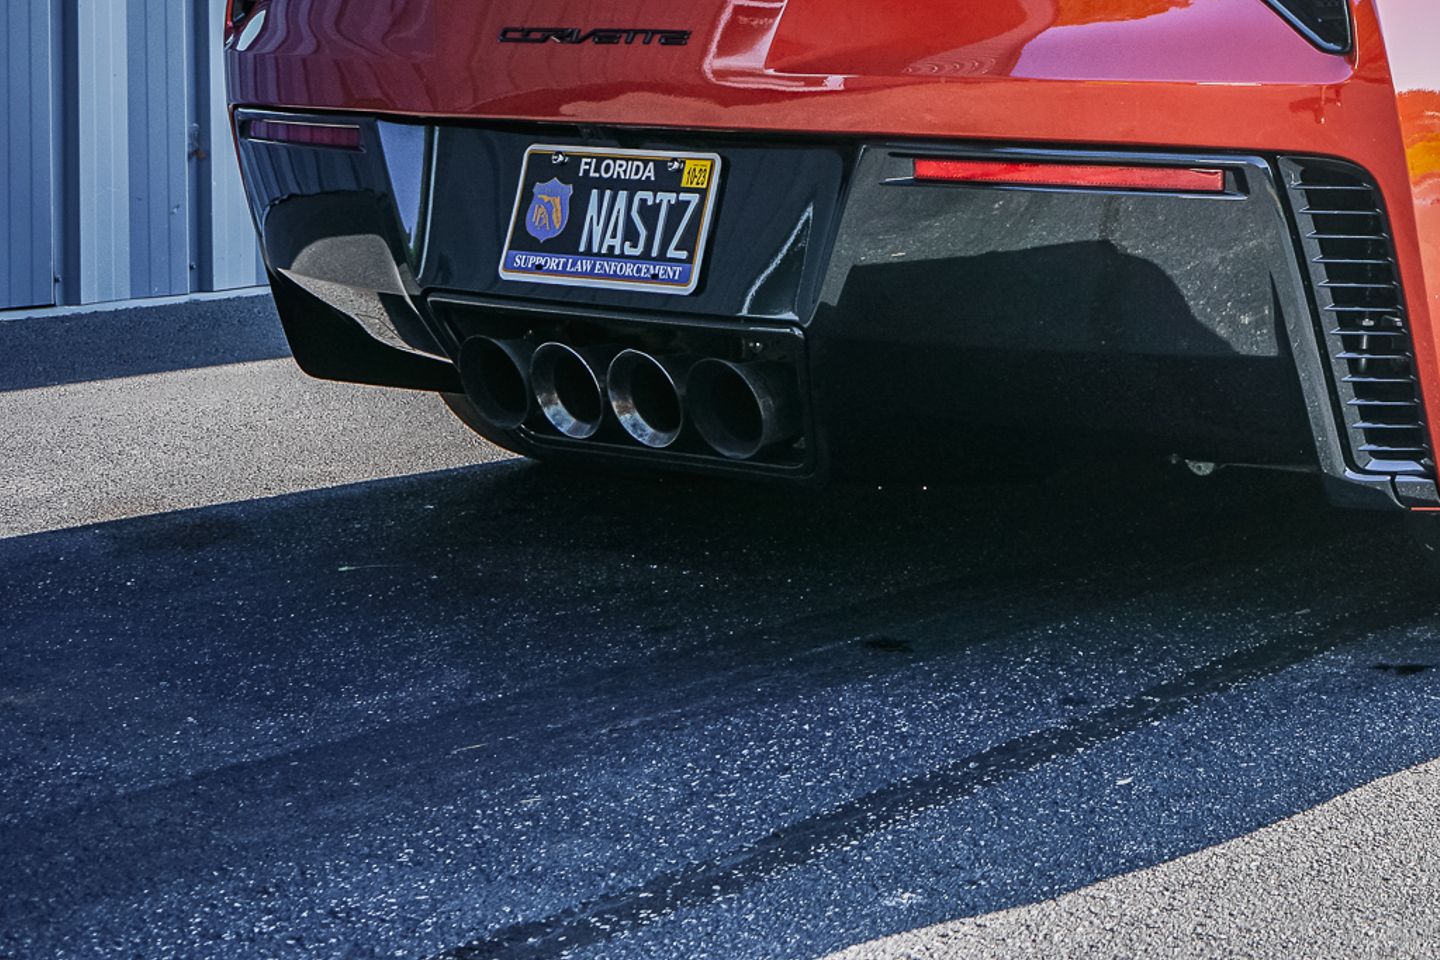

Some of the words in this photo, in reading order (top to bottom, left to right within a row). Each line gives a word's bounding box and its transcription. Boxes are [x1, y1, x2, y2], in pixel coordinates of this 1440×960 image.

[498, 28, 691, 45] CORVETTE
[578, 158, 656, 181] FLORIDA
[578, 188, 700, 260] NASTZ
[513, 254, 568, 272] SUPPORT
[567, 259, 594, 274] LAW
[594, 260, 683, 280] ENFORCEMENT
